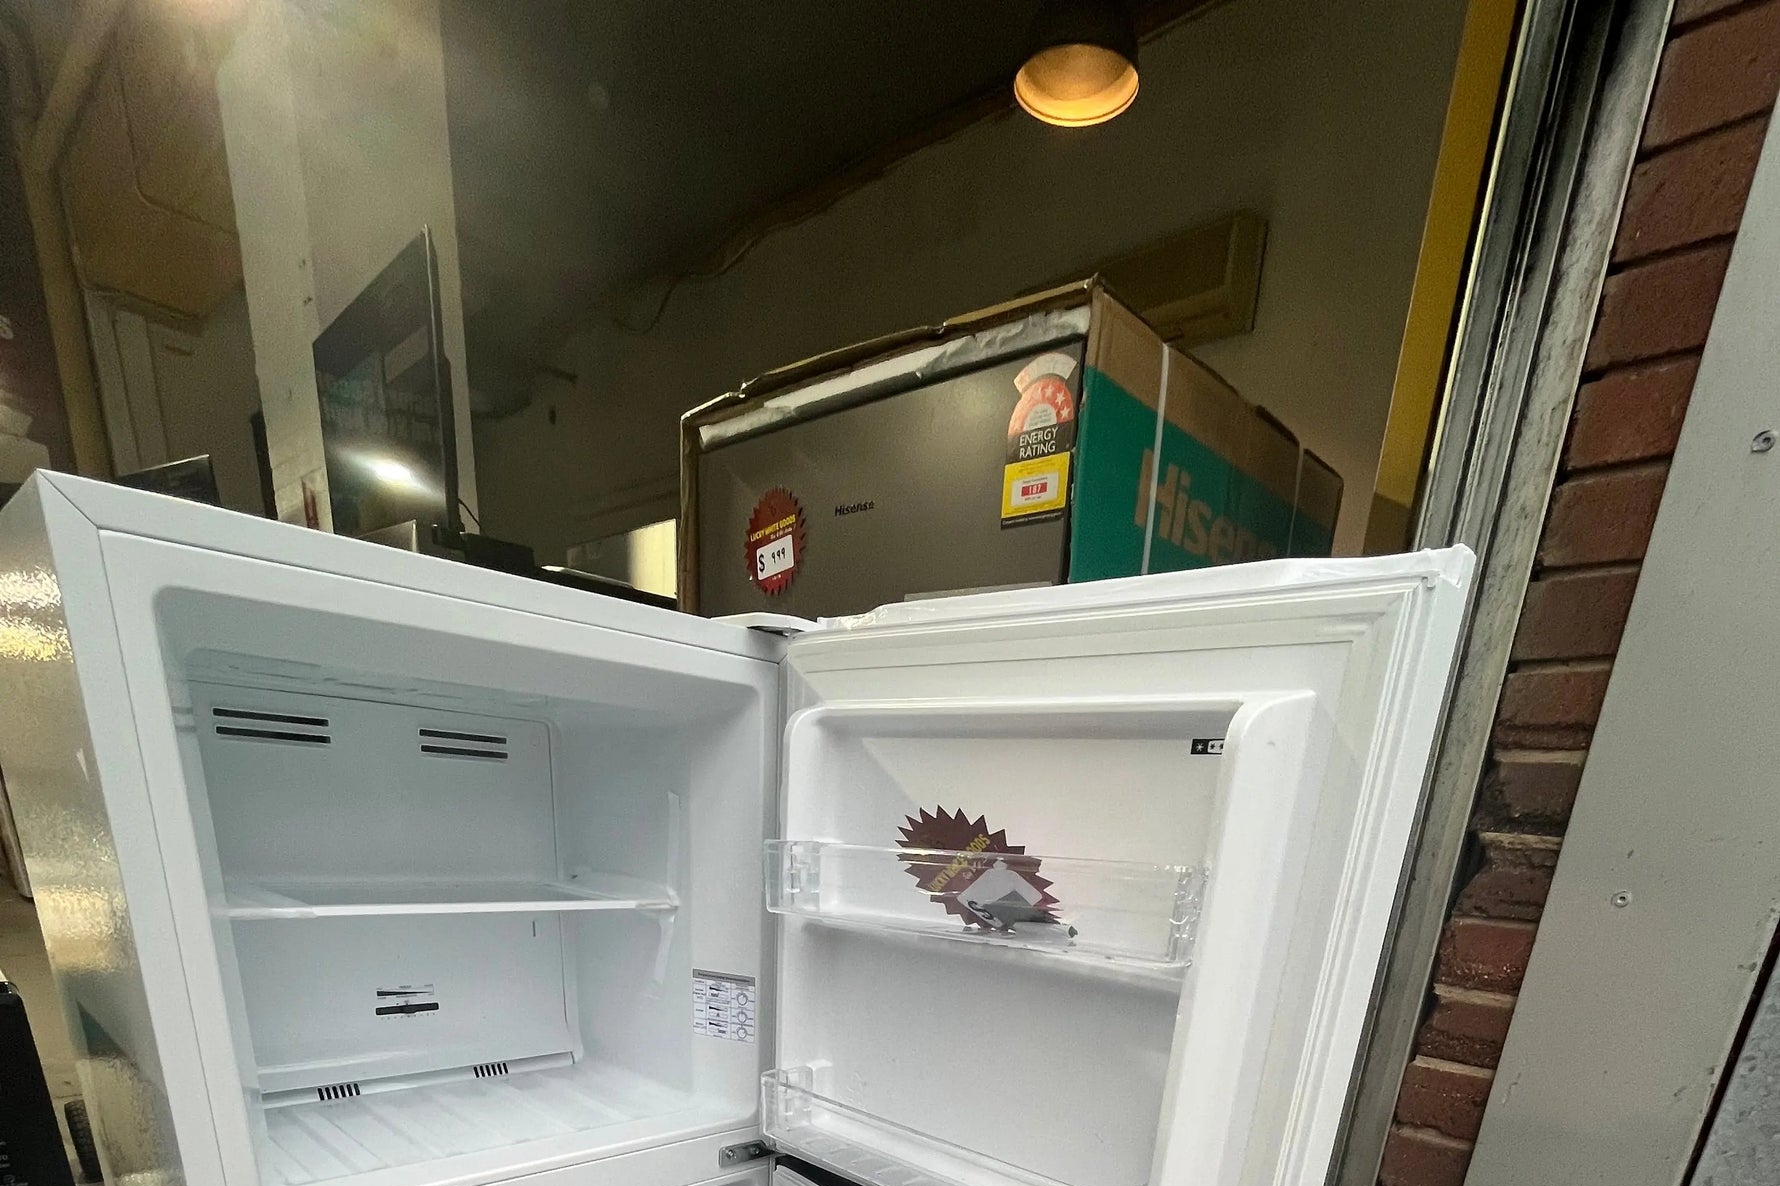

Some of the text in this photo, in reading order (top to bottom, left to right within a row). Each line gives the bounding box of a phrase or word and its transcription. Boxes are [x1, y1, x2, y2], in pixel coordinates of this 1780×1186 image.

[1019, 427, 1059, 447] ENERGY
[1019, 441, 1056, 459] RATING
[834, 500, 874, 516] Hisense
[750, 529, 765, 542] LUCKY
[780, 514, 796, 529] GOODS
[758, 547, 786, 573] $ 999
